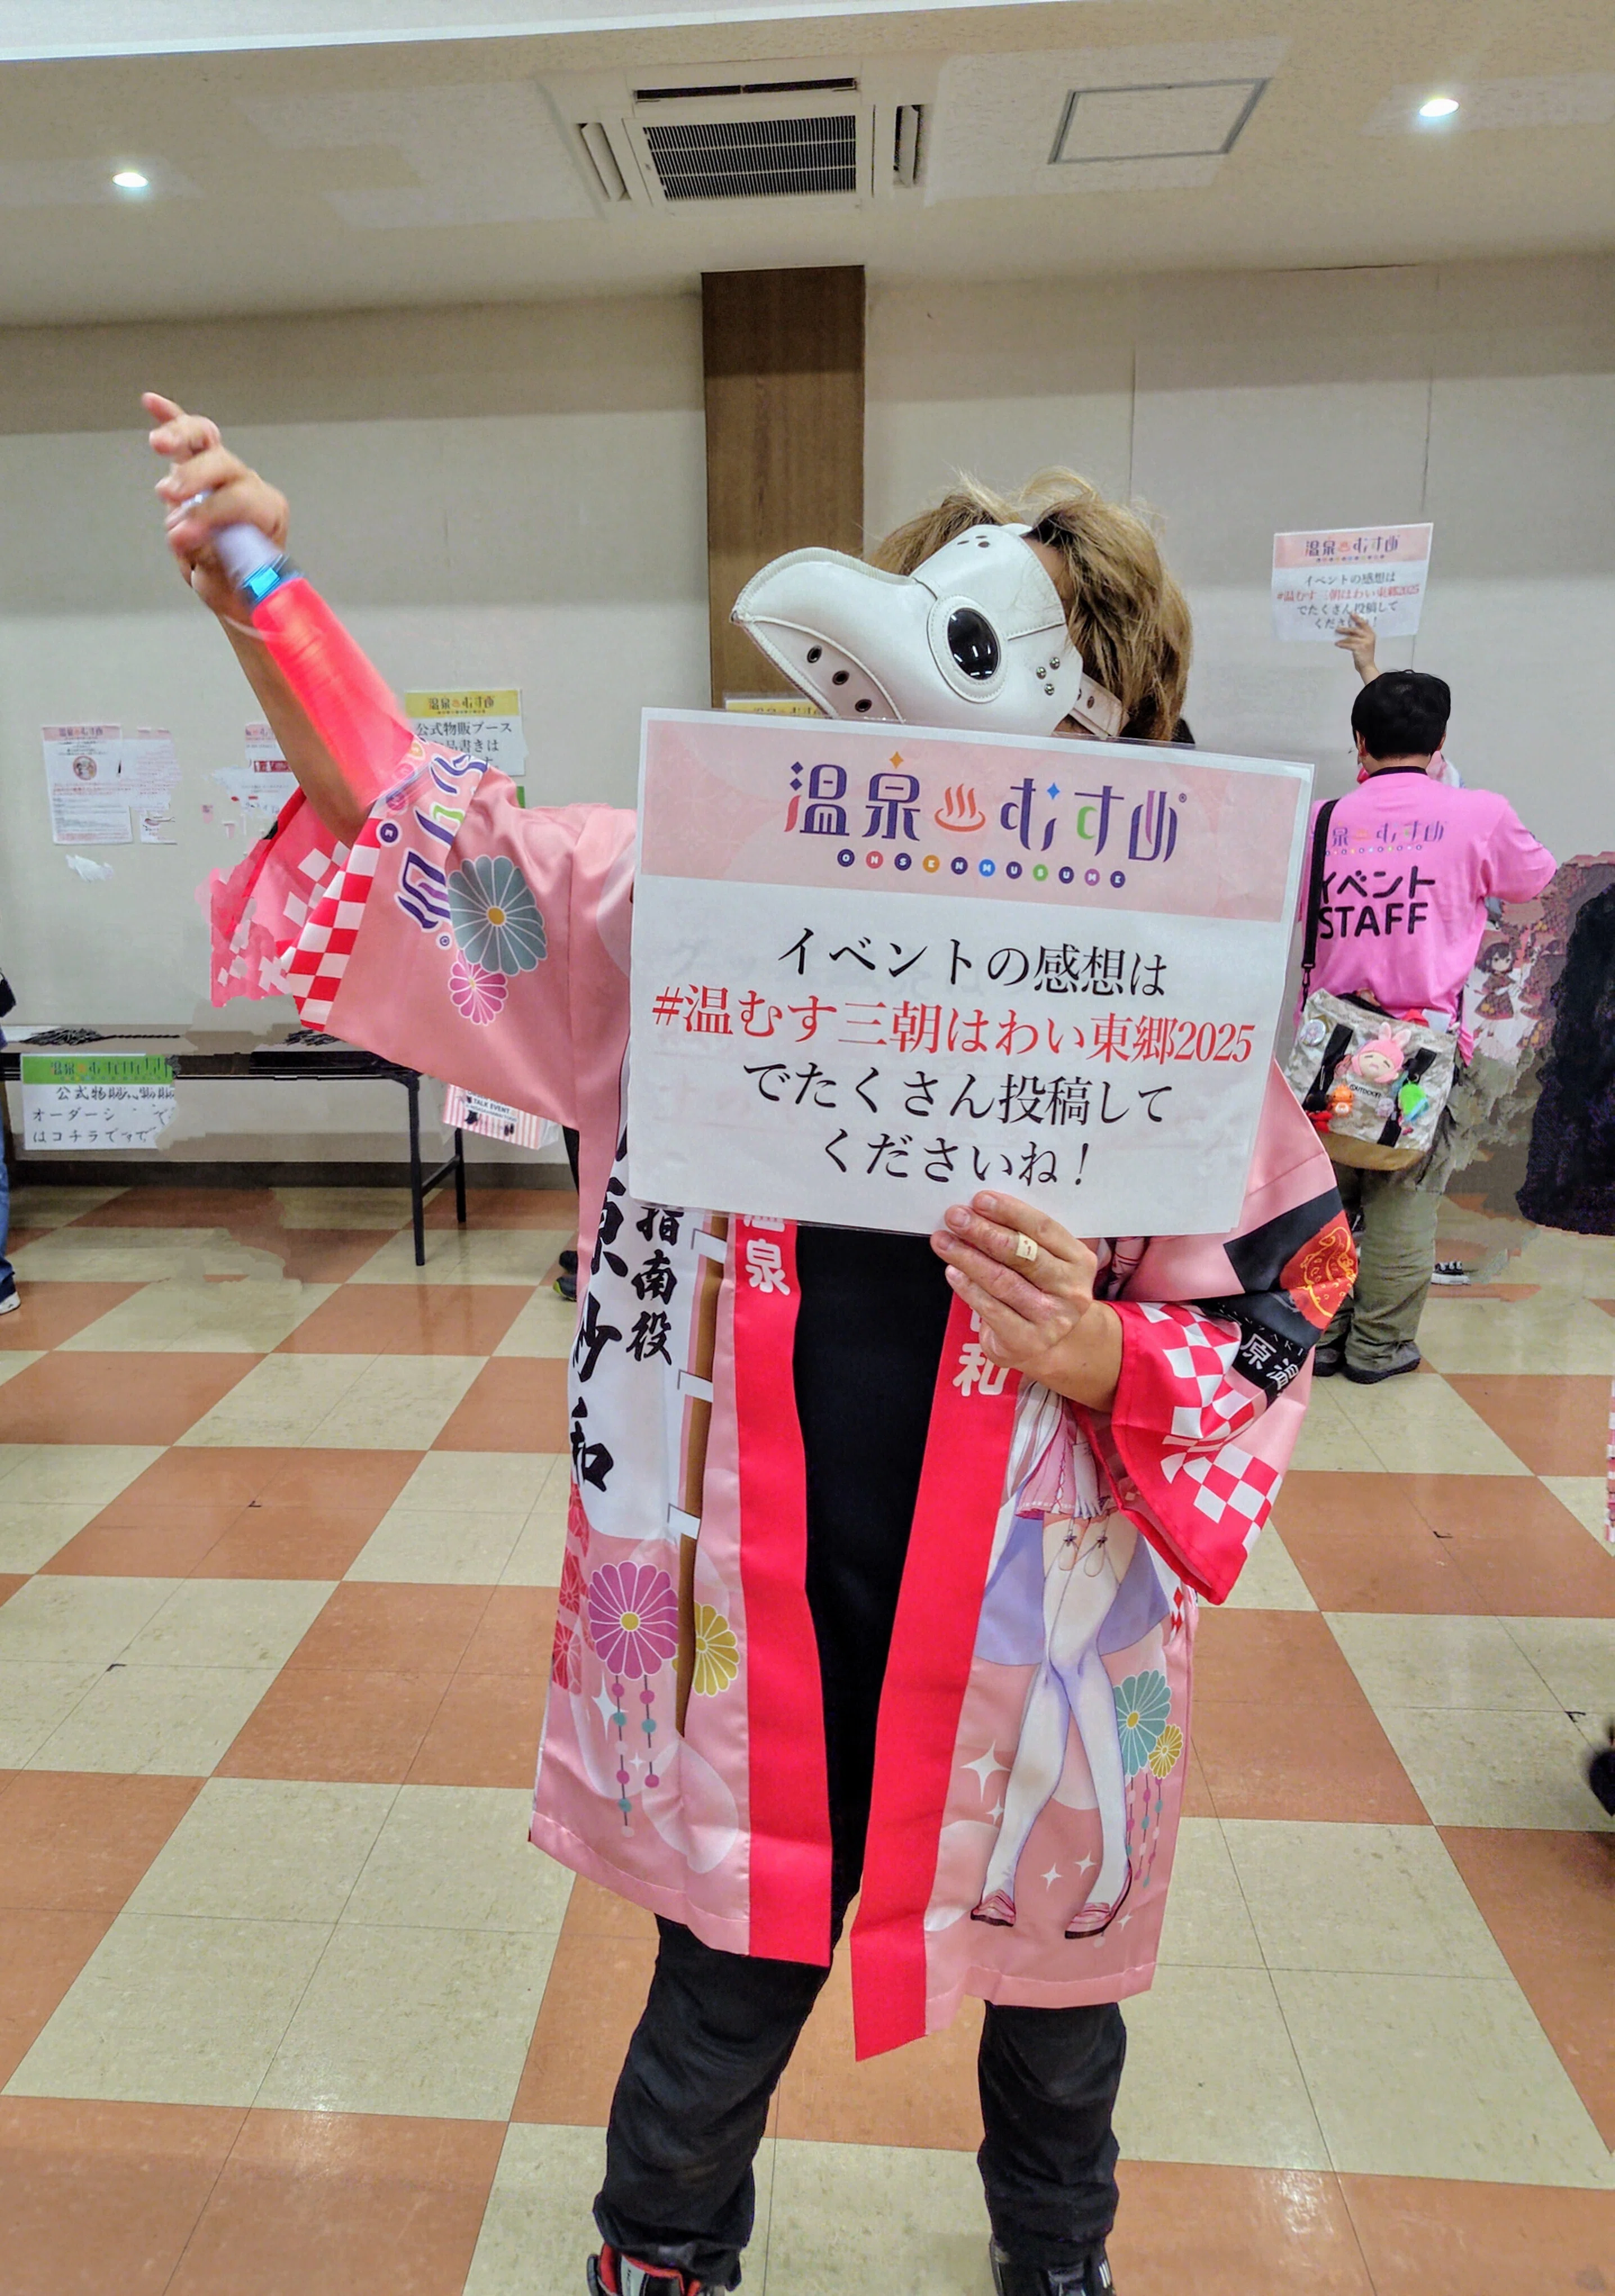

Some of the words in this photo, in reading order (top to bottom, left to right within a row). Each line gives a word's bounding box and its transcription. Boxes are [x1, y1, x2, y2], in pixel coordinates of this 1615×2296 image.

[417, 722, 512, 736] 公式物販ブース
[837, 848, 1125, 888] ONSENMUSUME
[1318, 902, 1428, 939] STAFF
[777, 927, 1168, 998] イベントの感想は
[651, 983, 1256, 1064] #温むす三朝はわい東郷2025
[743, 1060, 1174, 1124] でたくさん投稿して
[823, 1128, 1090, 1186] くださいね！
[953, 1308, 1010, 1397] 和
